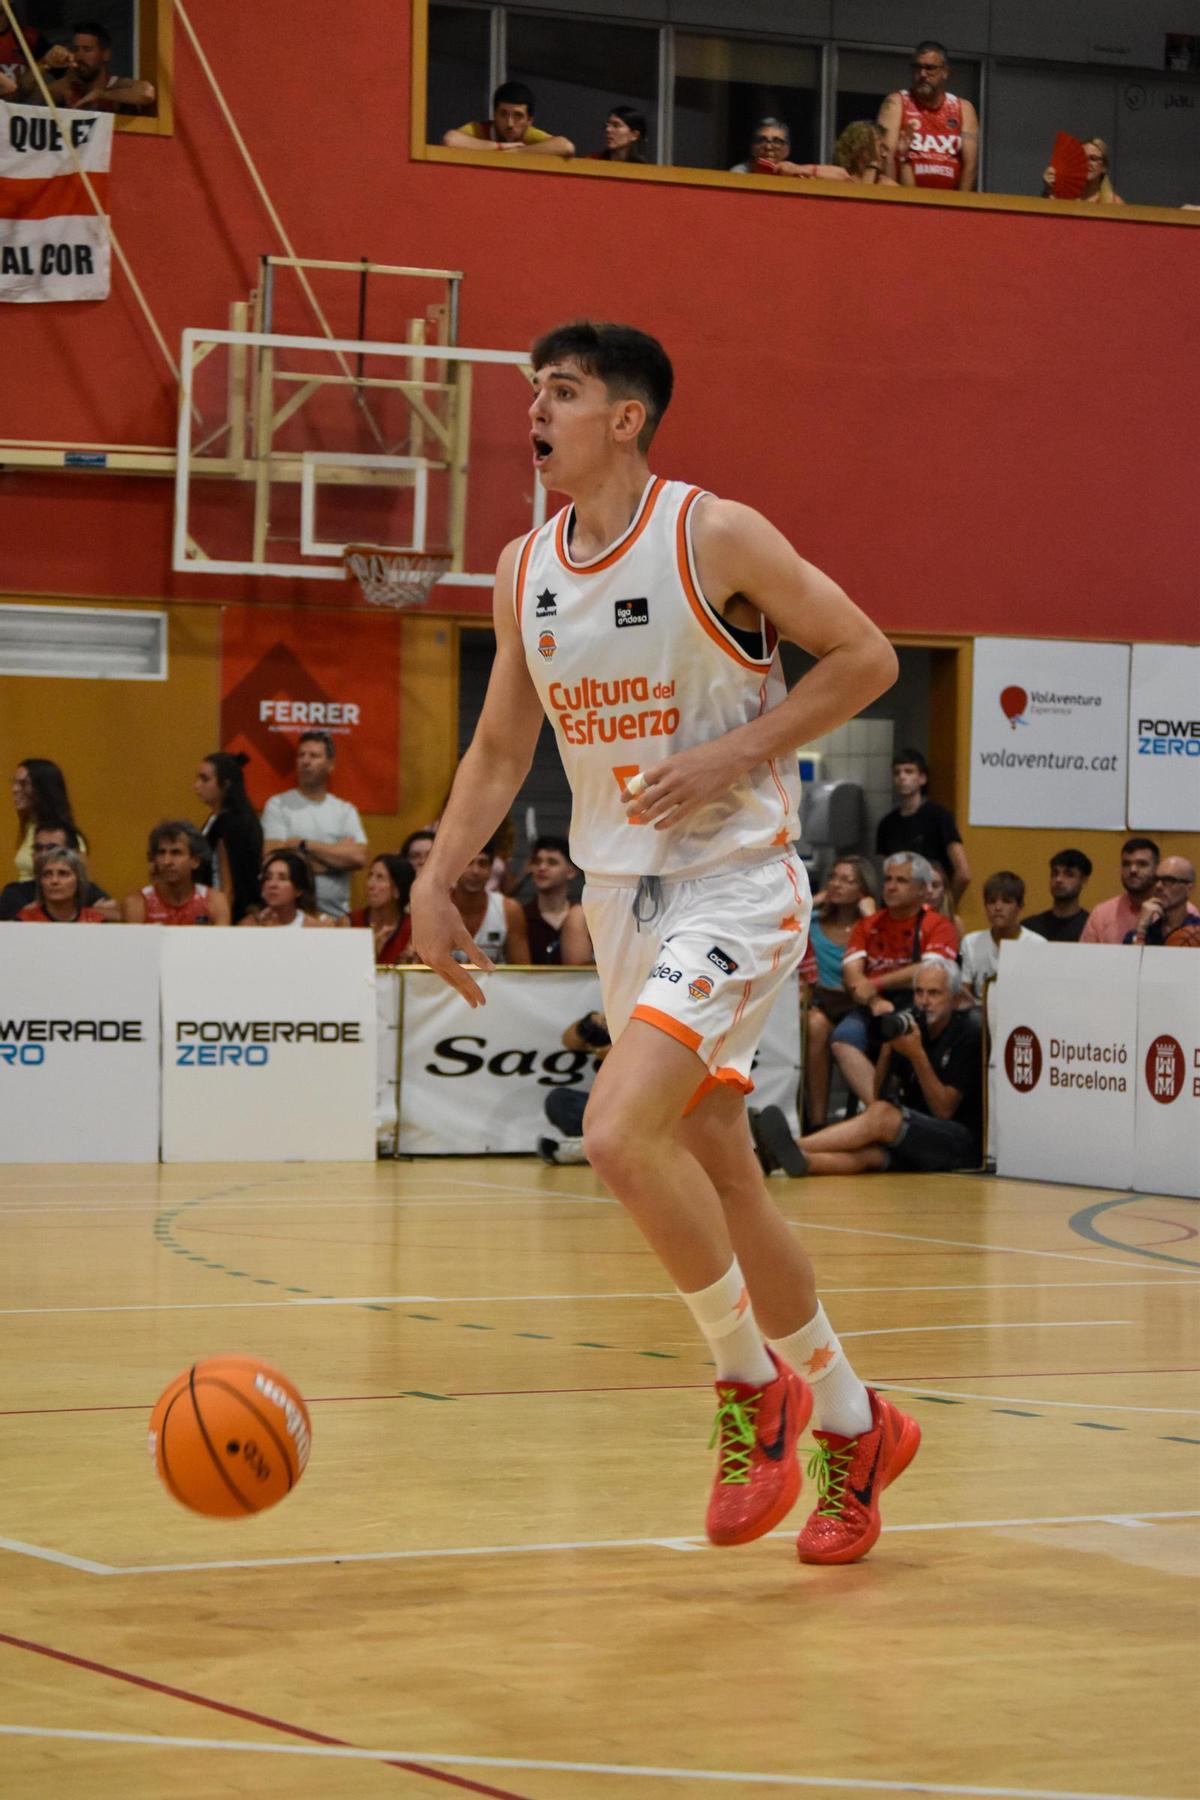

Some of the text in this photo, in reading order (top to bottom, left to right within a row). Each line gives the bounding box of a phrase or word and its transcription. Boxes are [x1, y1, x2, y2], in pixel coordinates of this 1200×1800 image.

[1, 243, 94, 275] AL COR
[548, 677, 676, 711] Cultura del
[259, 700, 361, 726] FERRER
[559, 706, 680, 745] Esfuerzo
[1138, 738, 1200, 757] ZERO
[980, 749, 1118, 772] volaventura.cat
[709, 953, 729, 971] acb
[176, 1021, 361, 1043] POWERADE
[176, 1045, 269, 1067] ZERO
[425, 1035, 602, 1086] Sag
[1050, 1039, 1127, 1064] Diputació
[1050, 1066, 1127, 1092] Barcelona
